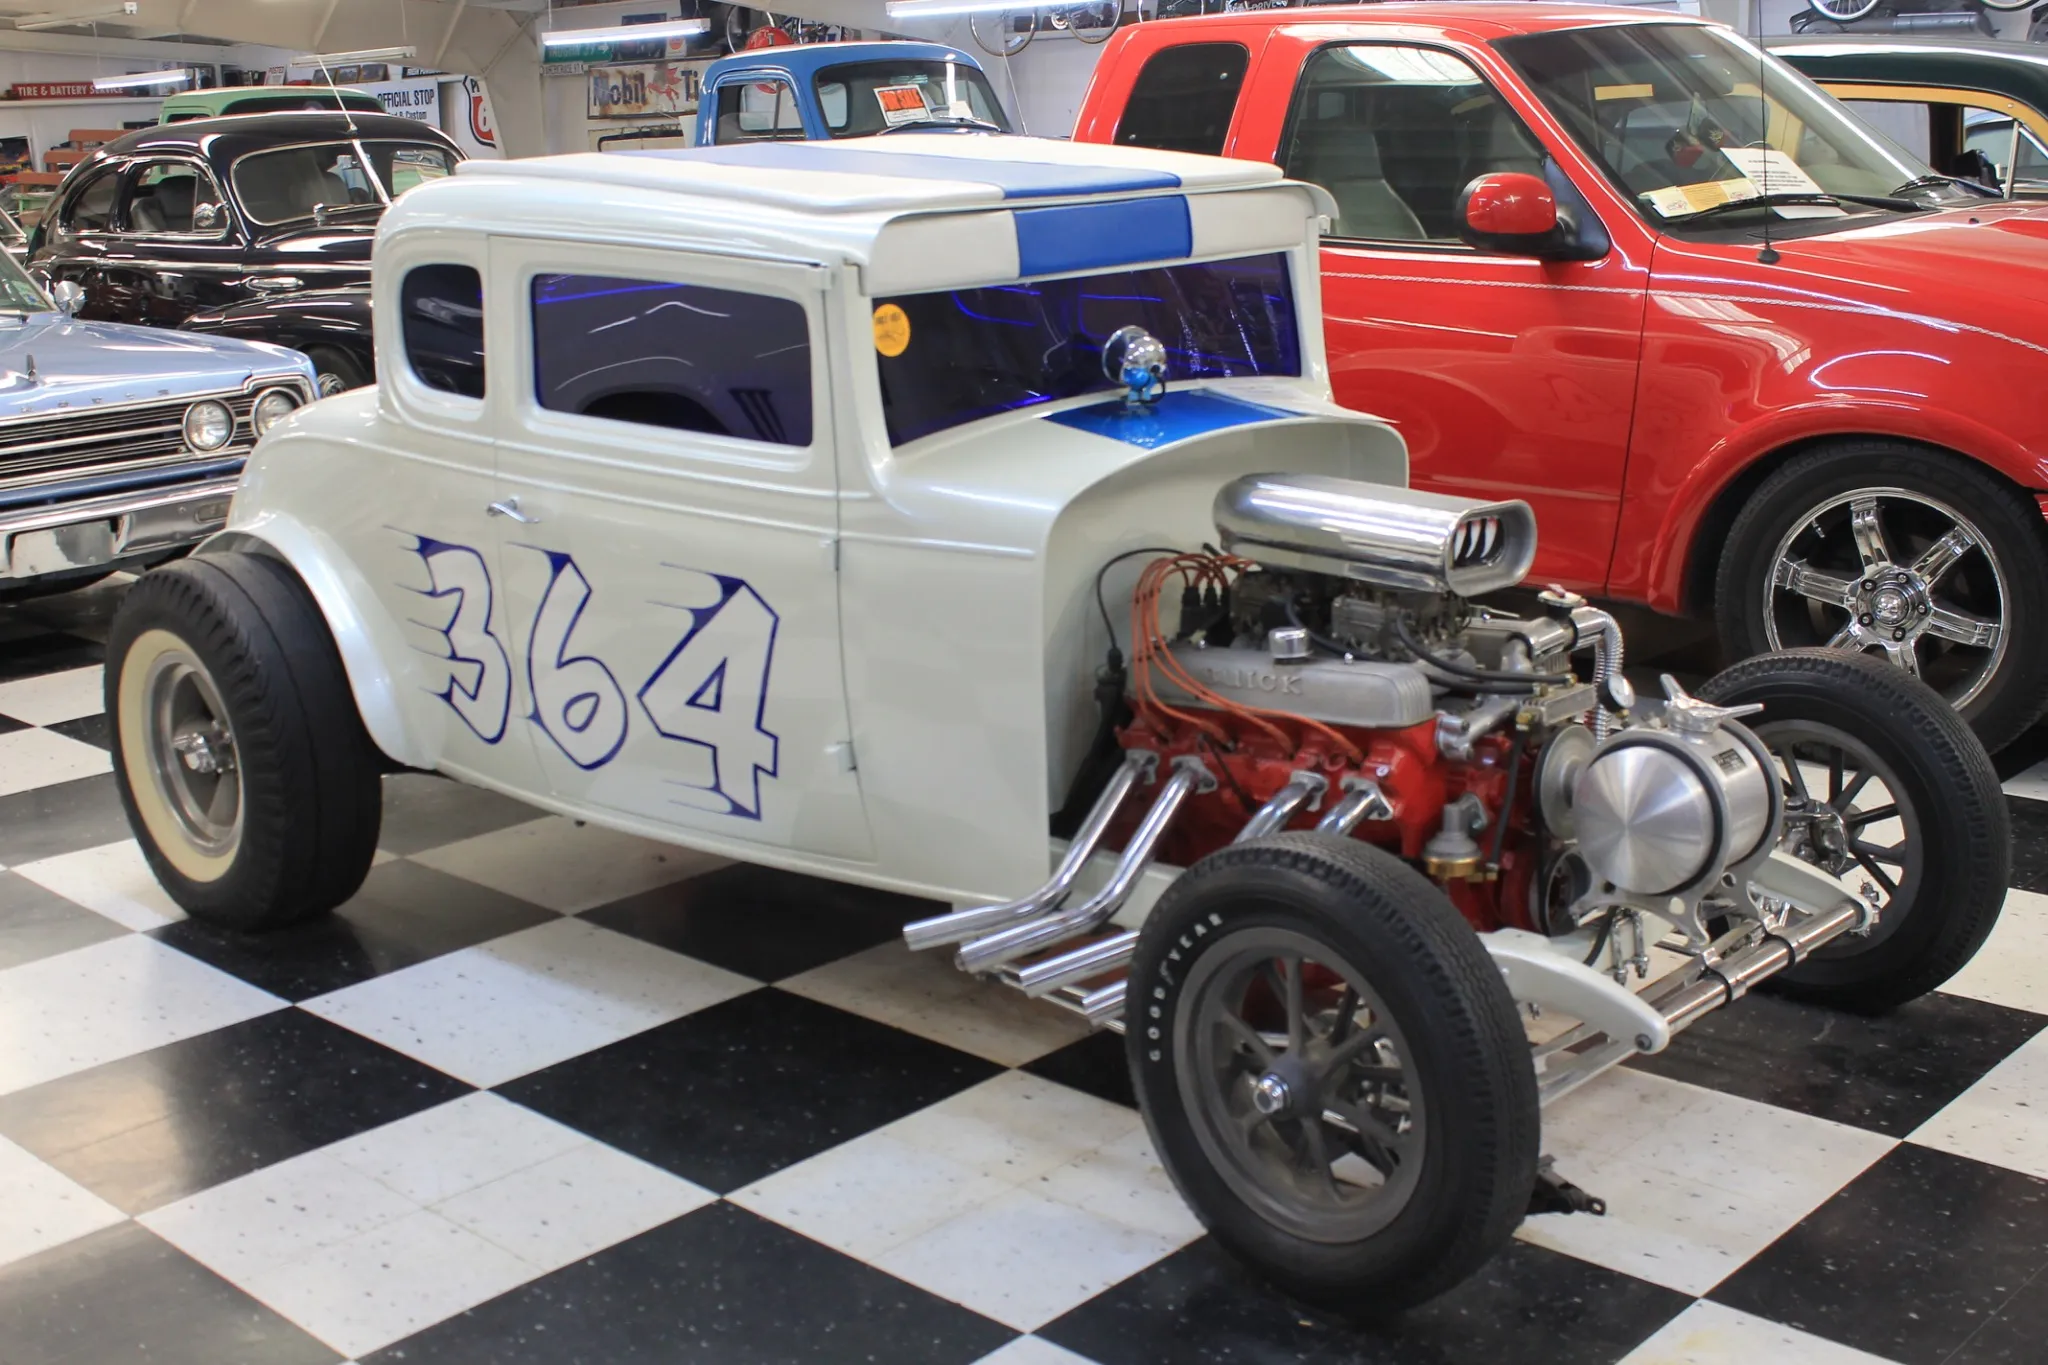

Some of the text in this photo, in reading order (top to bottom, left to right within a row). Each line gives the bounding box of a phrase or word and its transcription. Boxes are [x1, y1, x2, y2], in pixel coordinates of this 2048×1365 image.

[18, 86, 38, 97] TIRE
[41, 86, 48, 95] &
[50, 85, 87, 95] BATTERY
[377, 88, 435, 108] OFFICIAL STOP
[594, 71, 647, 106] Mobil
[405, 110, 427, 120] Custom
[382, 524, 780, 820] 364
